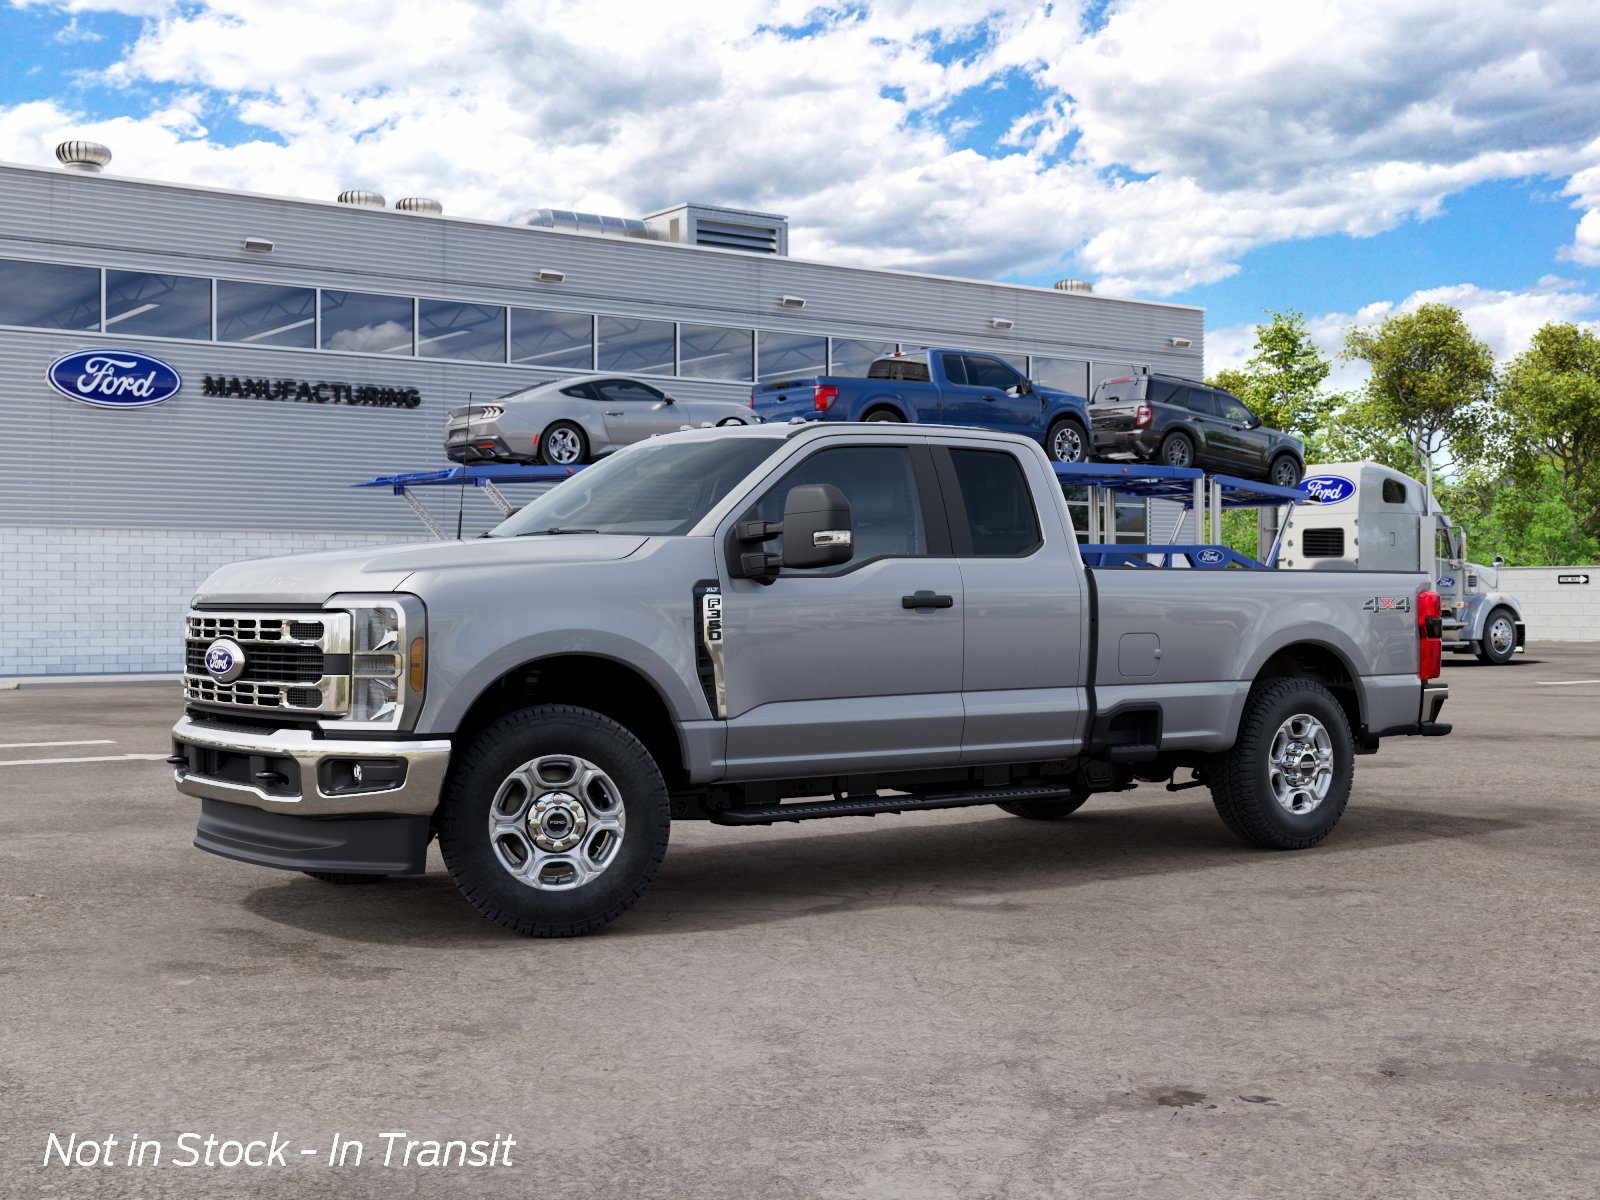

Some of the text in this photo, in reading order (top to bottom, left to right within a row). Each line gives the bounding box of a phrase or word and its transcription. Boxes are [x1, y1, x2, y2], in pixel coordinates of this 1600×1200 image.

[77, 357, 157, 398] Ford
[203, 374, 421, 408] MANUFACTURING
[1305, 479, 1343, 500] Ford
[1201, 550, 1220, 562] Ford
[210, 650, 229, 670] Ford
